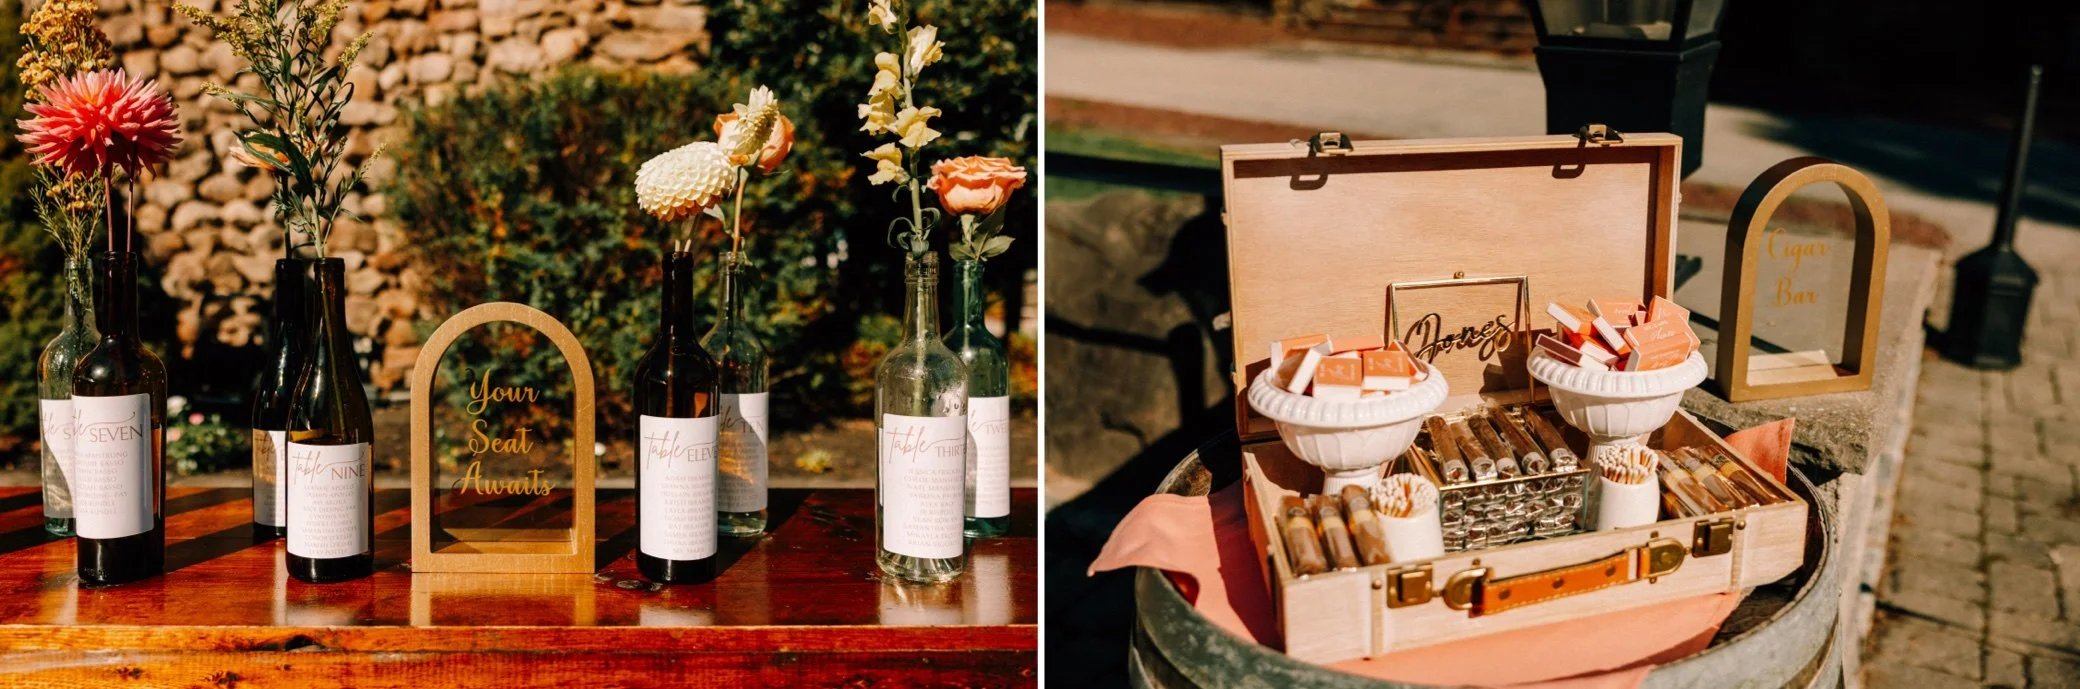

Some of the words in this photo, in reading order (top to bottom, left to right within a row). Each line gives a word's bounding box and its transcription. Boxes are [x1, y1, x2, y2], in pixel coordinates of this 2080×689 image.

[1767, 227, 1828, 273] Cigar
[1773, 276, 1819, 307] Bar
[465, 368, 540, 415] Your
[89, 423, 144, 444] SEVEN
[468, 419, 534, 457] Seat
[331, 463, 366, 481] NINE
[452, 460, 556, 496] Awaits
